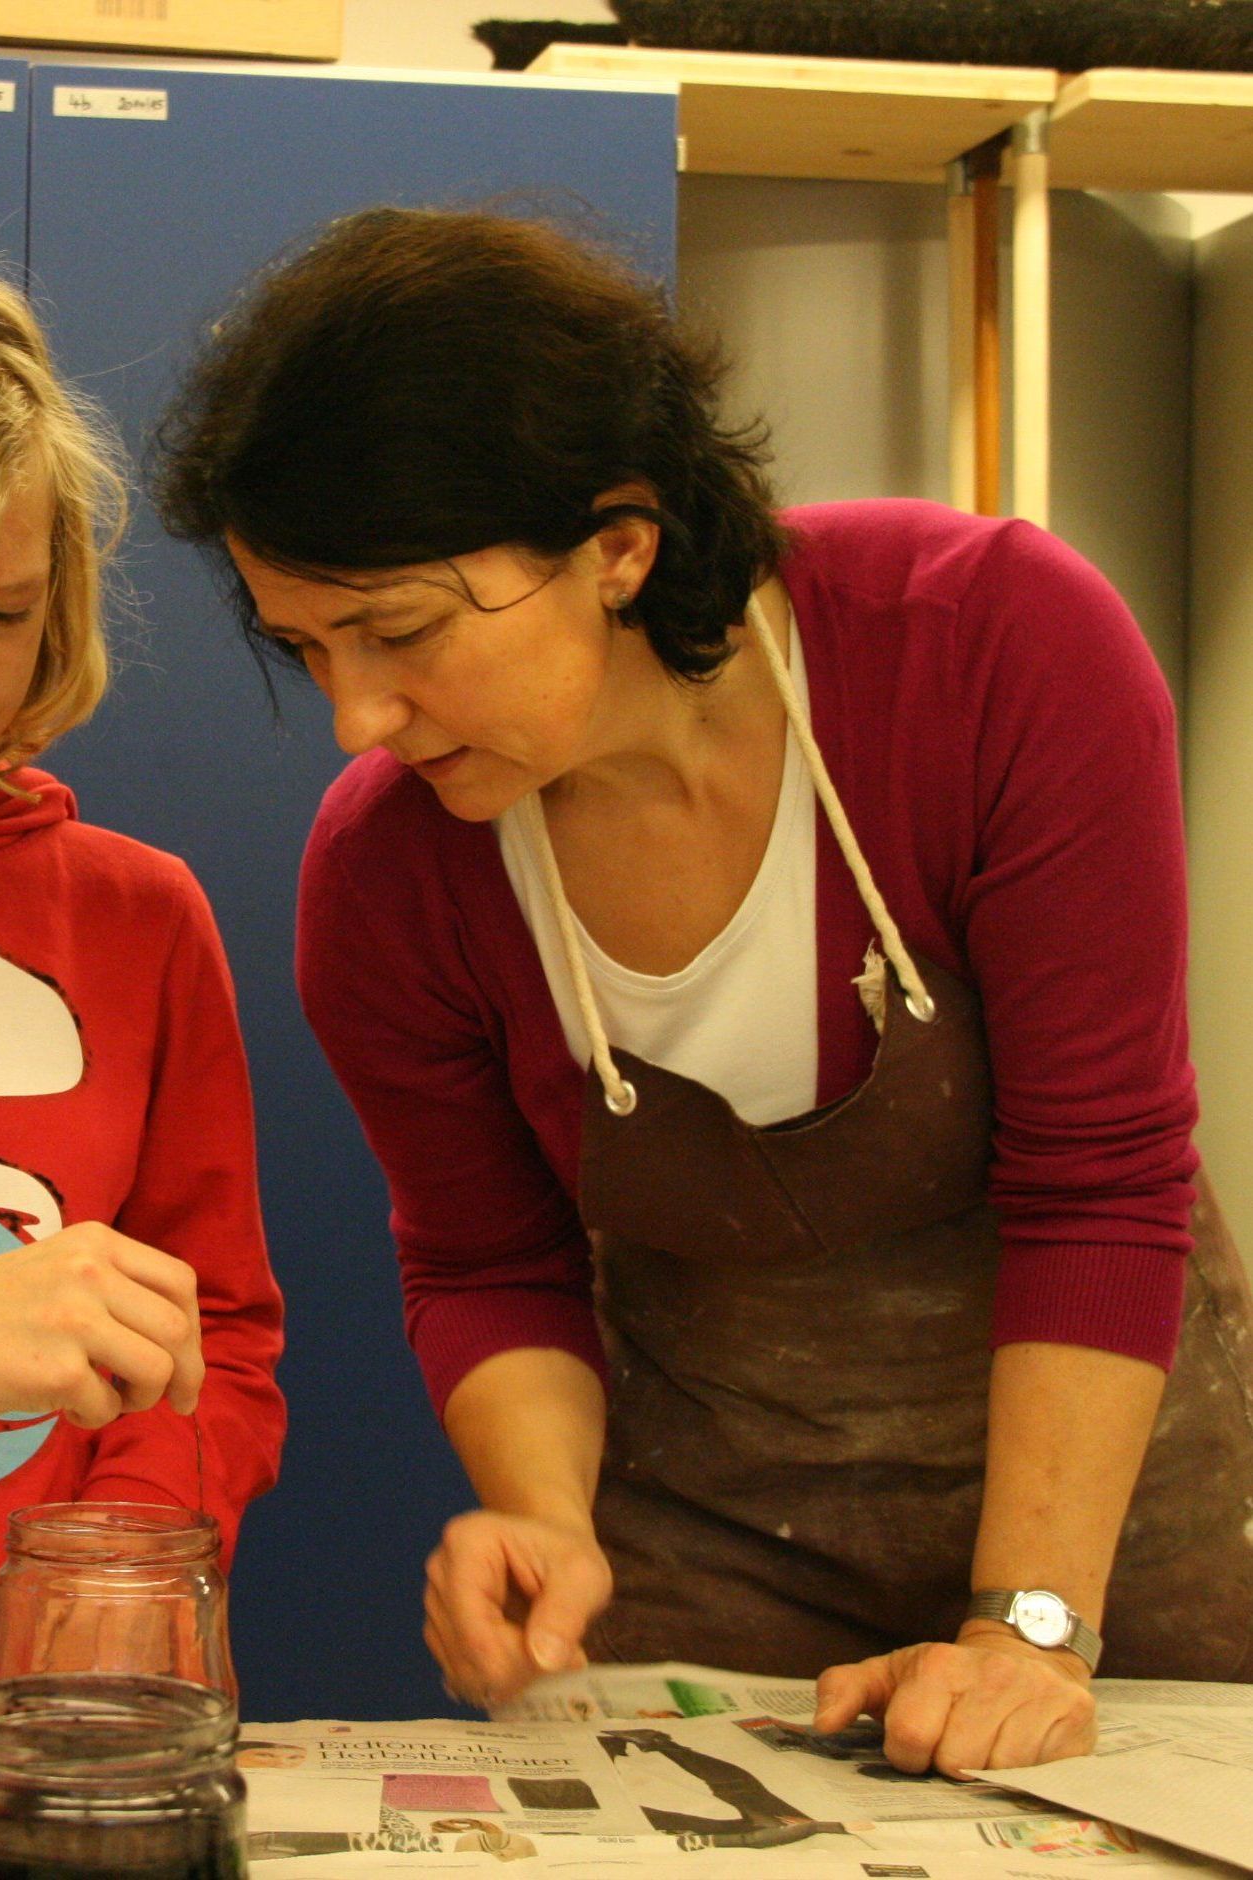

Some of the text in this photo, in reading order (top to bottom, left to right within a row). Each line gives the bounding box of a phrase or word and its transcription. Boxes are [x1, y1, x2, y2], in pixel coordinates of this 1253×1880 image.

[316, 1740, 503, 1754] Erdtöne als
[320, 1750, 573, 1767] Herbstbegleiter
